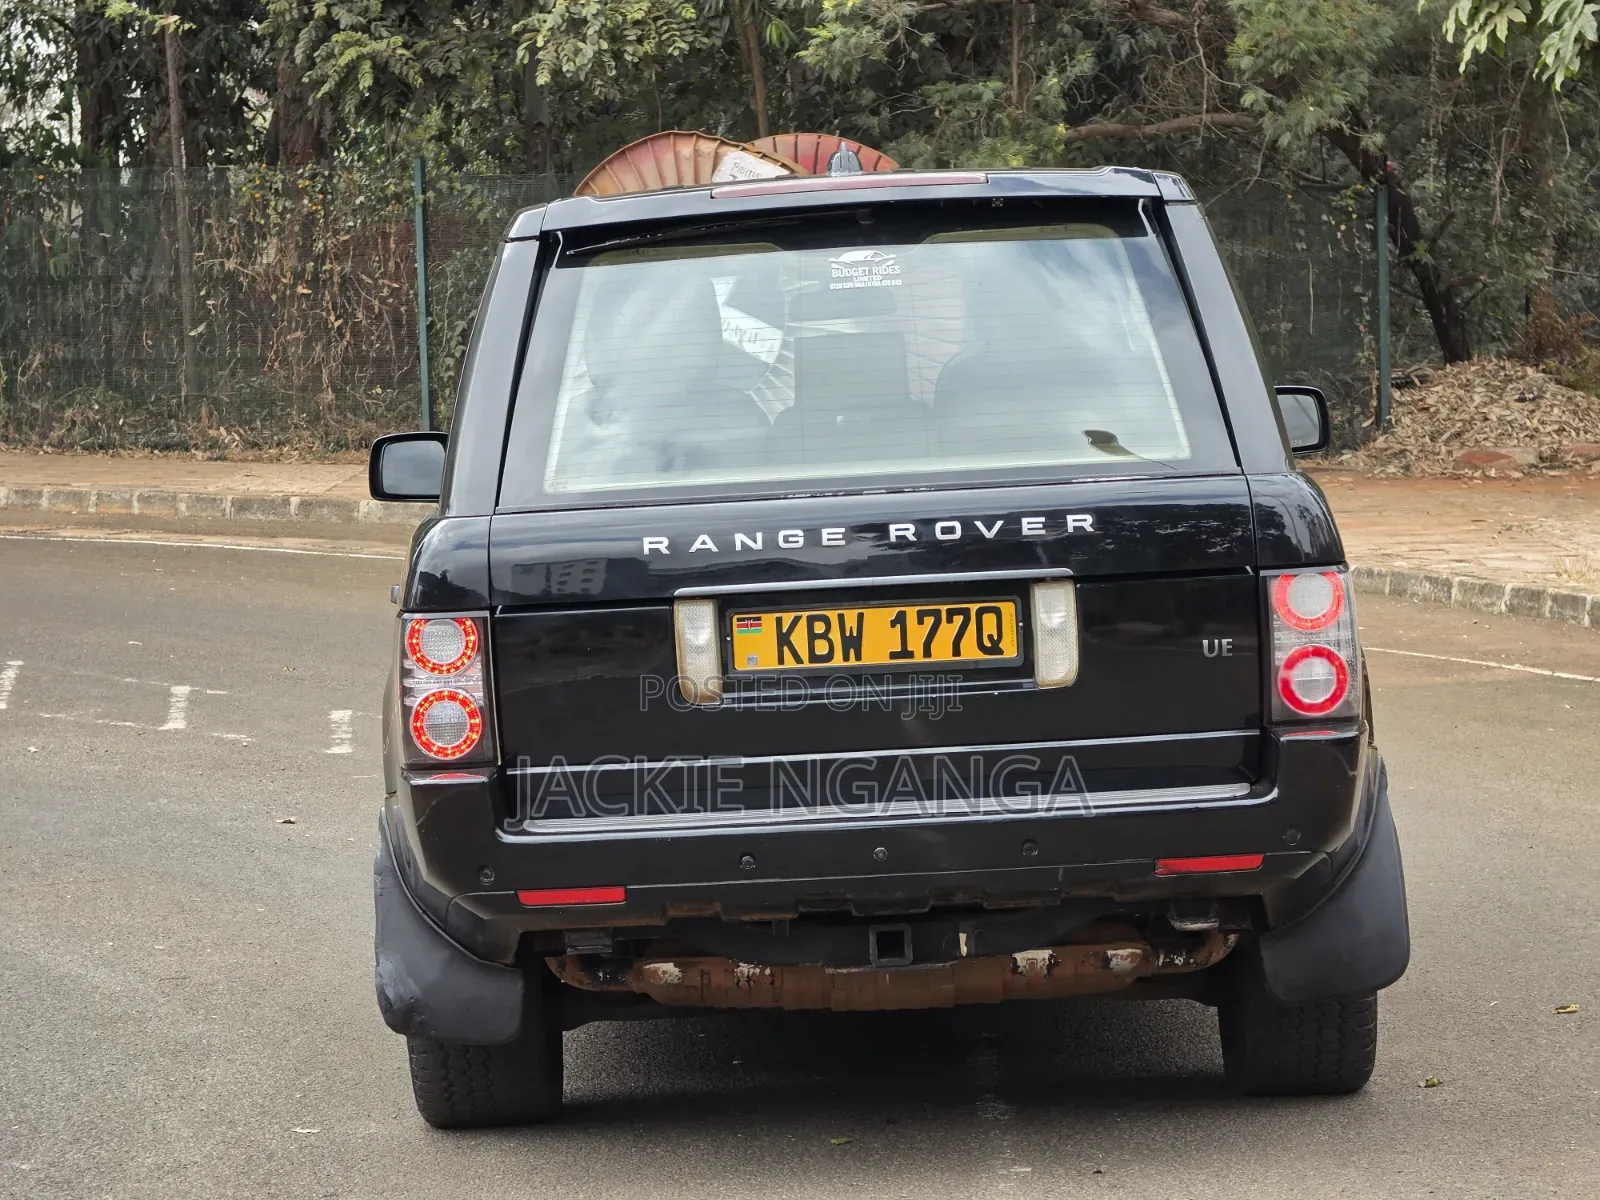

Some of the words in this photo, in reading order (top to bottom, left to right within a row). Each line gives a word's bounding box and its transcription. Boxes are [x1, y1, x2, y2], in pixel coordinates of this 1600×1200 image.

[831, 267, 870, 278] BUDGET
[872, 265, 901, 275] RIDES
[642, 526, 847, 555] RANGE
[888, 513, 1095, 543] ROVER
[775, 611, 865, 666] KBW
[889, 606, 1005, 660] 177Q
[1202, 638, 1233, 658] UE
